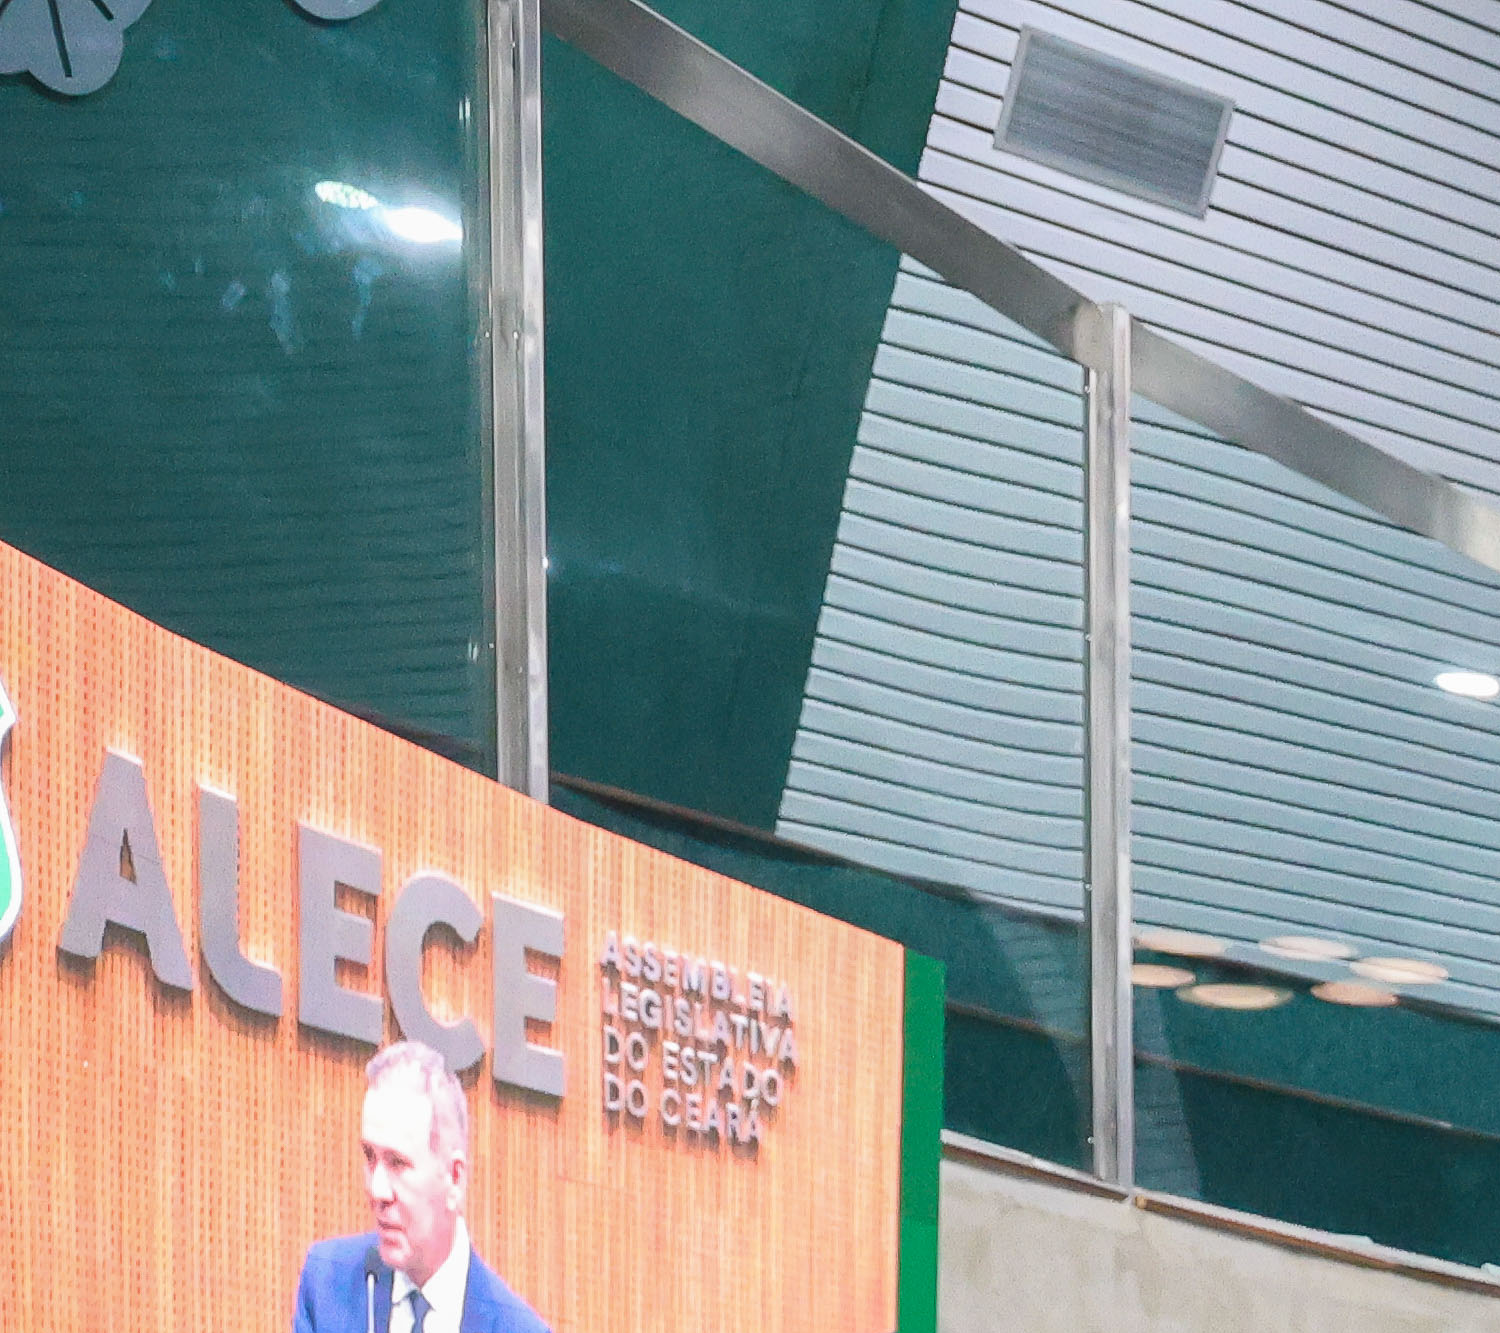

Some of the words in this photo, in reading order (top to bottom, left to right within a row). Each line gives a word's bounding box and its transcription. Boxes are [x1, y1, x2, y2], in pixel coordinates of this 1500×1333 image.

[57, 743, 565, 1098] ALECE
[601, 930, 792, 1021] ASSEMBLEIA
[602, 976, 798, 1062] LEGISLATIVA
[603, 1024, 649, 1072] DO
[662, 1040, 784, 1107] ESTADO
[603, 1071, 650, 1118] DO
[660, 1087, 763, 1142] CEARÁ
